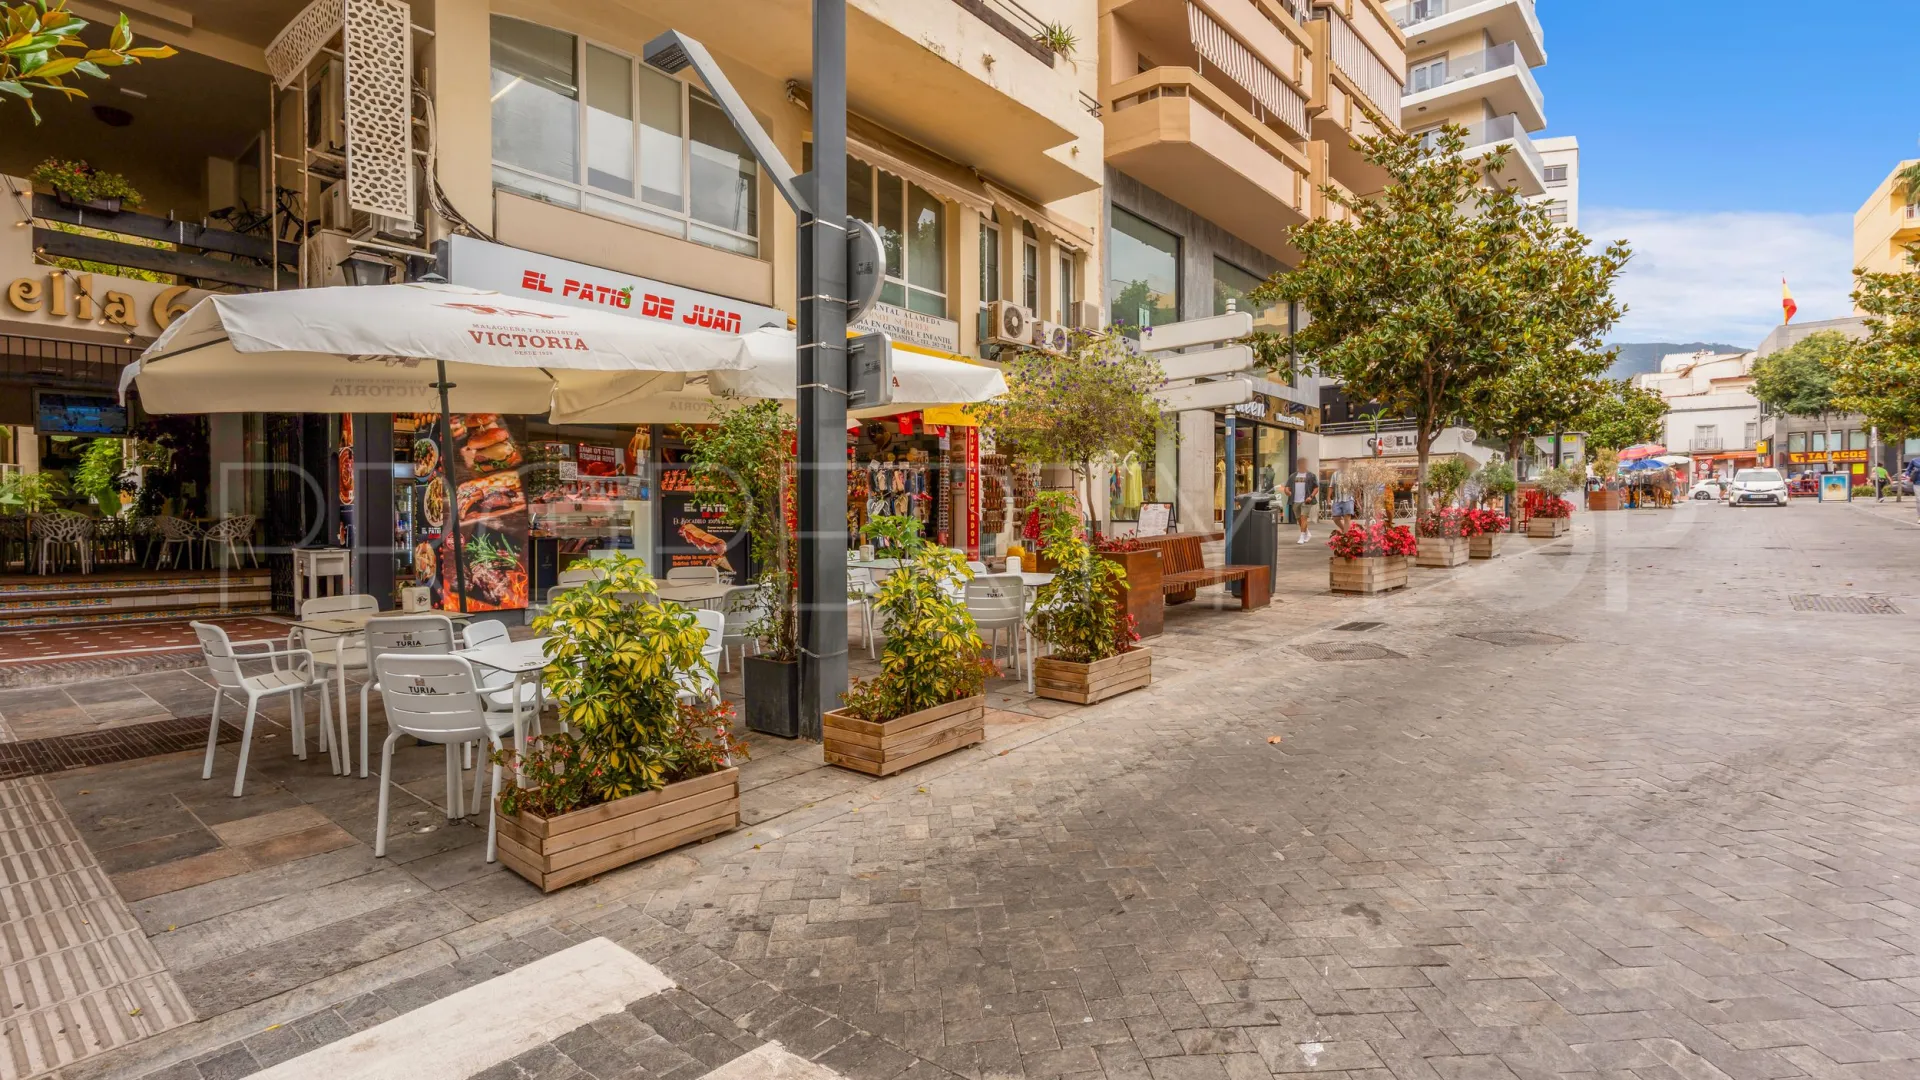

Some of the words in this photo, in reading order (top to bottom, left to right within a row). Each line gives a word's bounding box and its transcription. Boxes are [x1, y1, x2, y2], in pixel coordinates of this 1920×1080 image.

[521, 269, 553, 293] EL
[562, 278, 632, 310] PATIO
[641, 293, 675, 321] DE
[682, 304, 742, 334] JUAN
[903, 313, 941, 326] ALAMEDA
[468, 330, 589, 351] VICTORIA
[882, 323, 915, 336] GENERAL
[922, 333, 952, 345] INFANTIL
[683, 503, 697, 513] EL
[408, 685, 437, 694] TURIA
